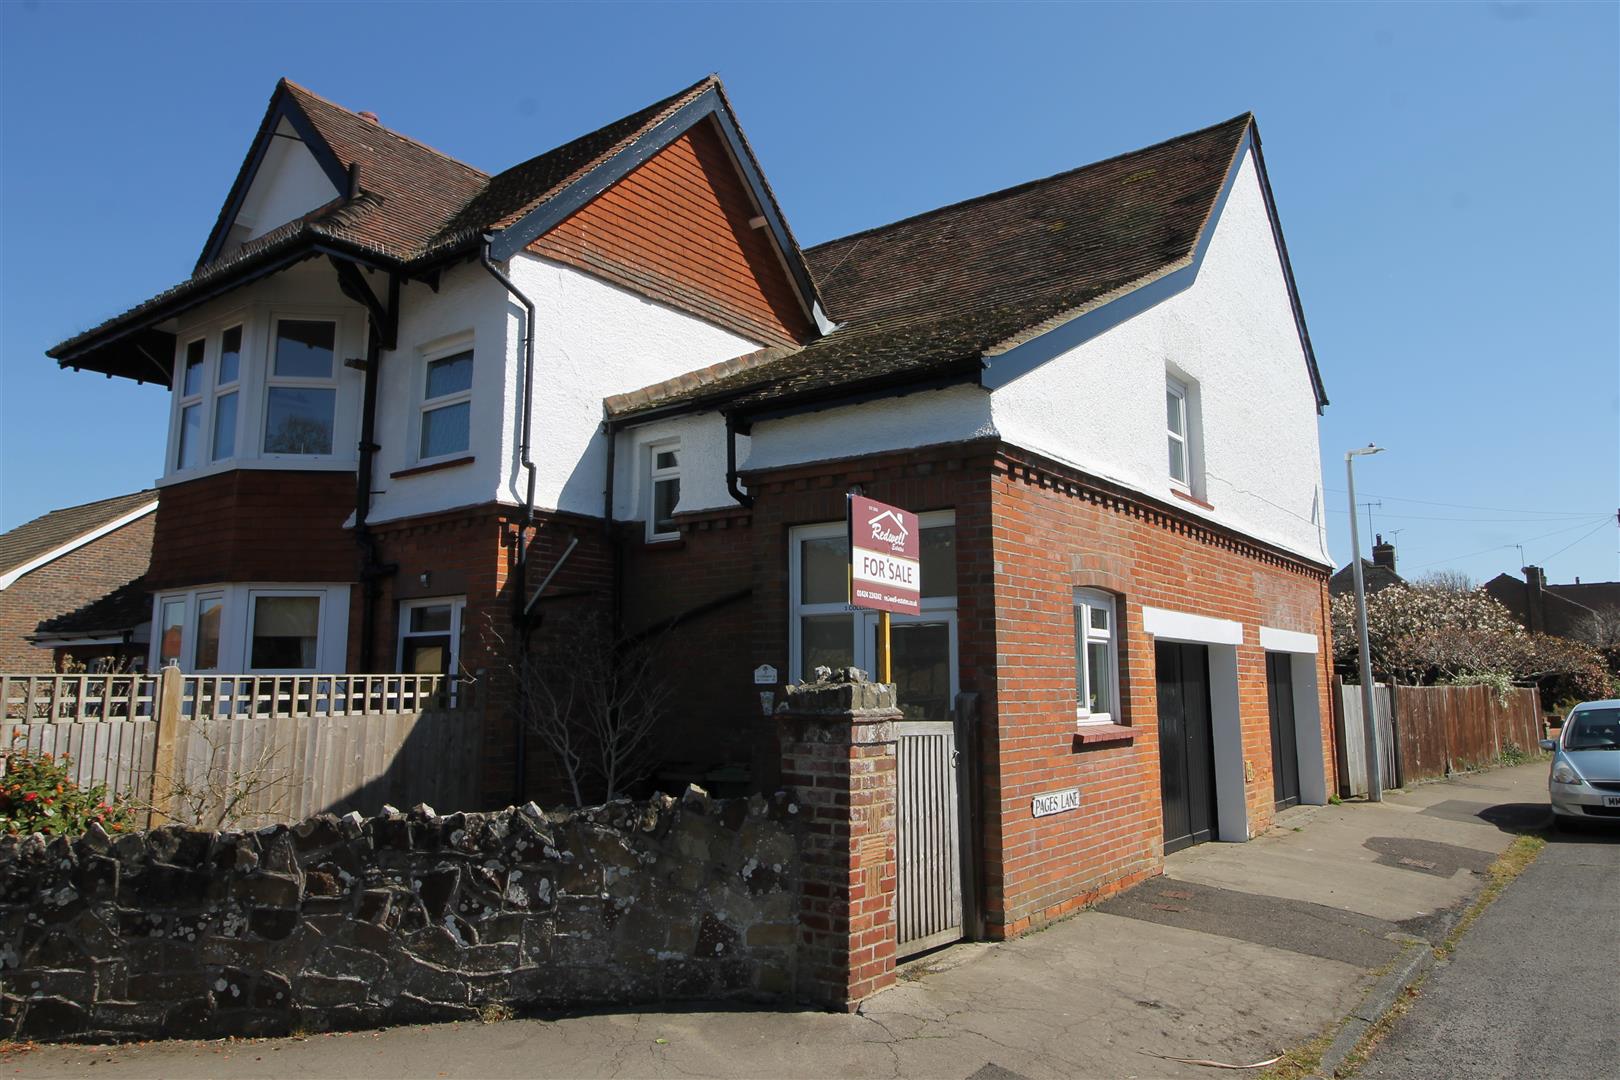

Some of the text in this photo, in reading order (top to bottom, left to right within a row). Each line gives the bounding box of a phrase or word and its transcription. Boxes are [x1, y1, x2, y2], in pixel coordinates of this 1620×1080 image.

[871, 523, 905, 546] Redwell
[863, 556, 912, 584] FOR SALE
[1035, 791, 1078, 815] PAGES LANE
